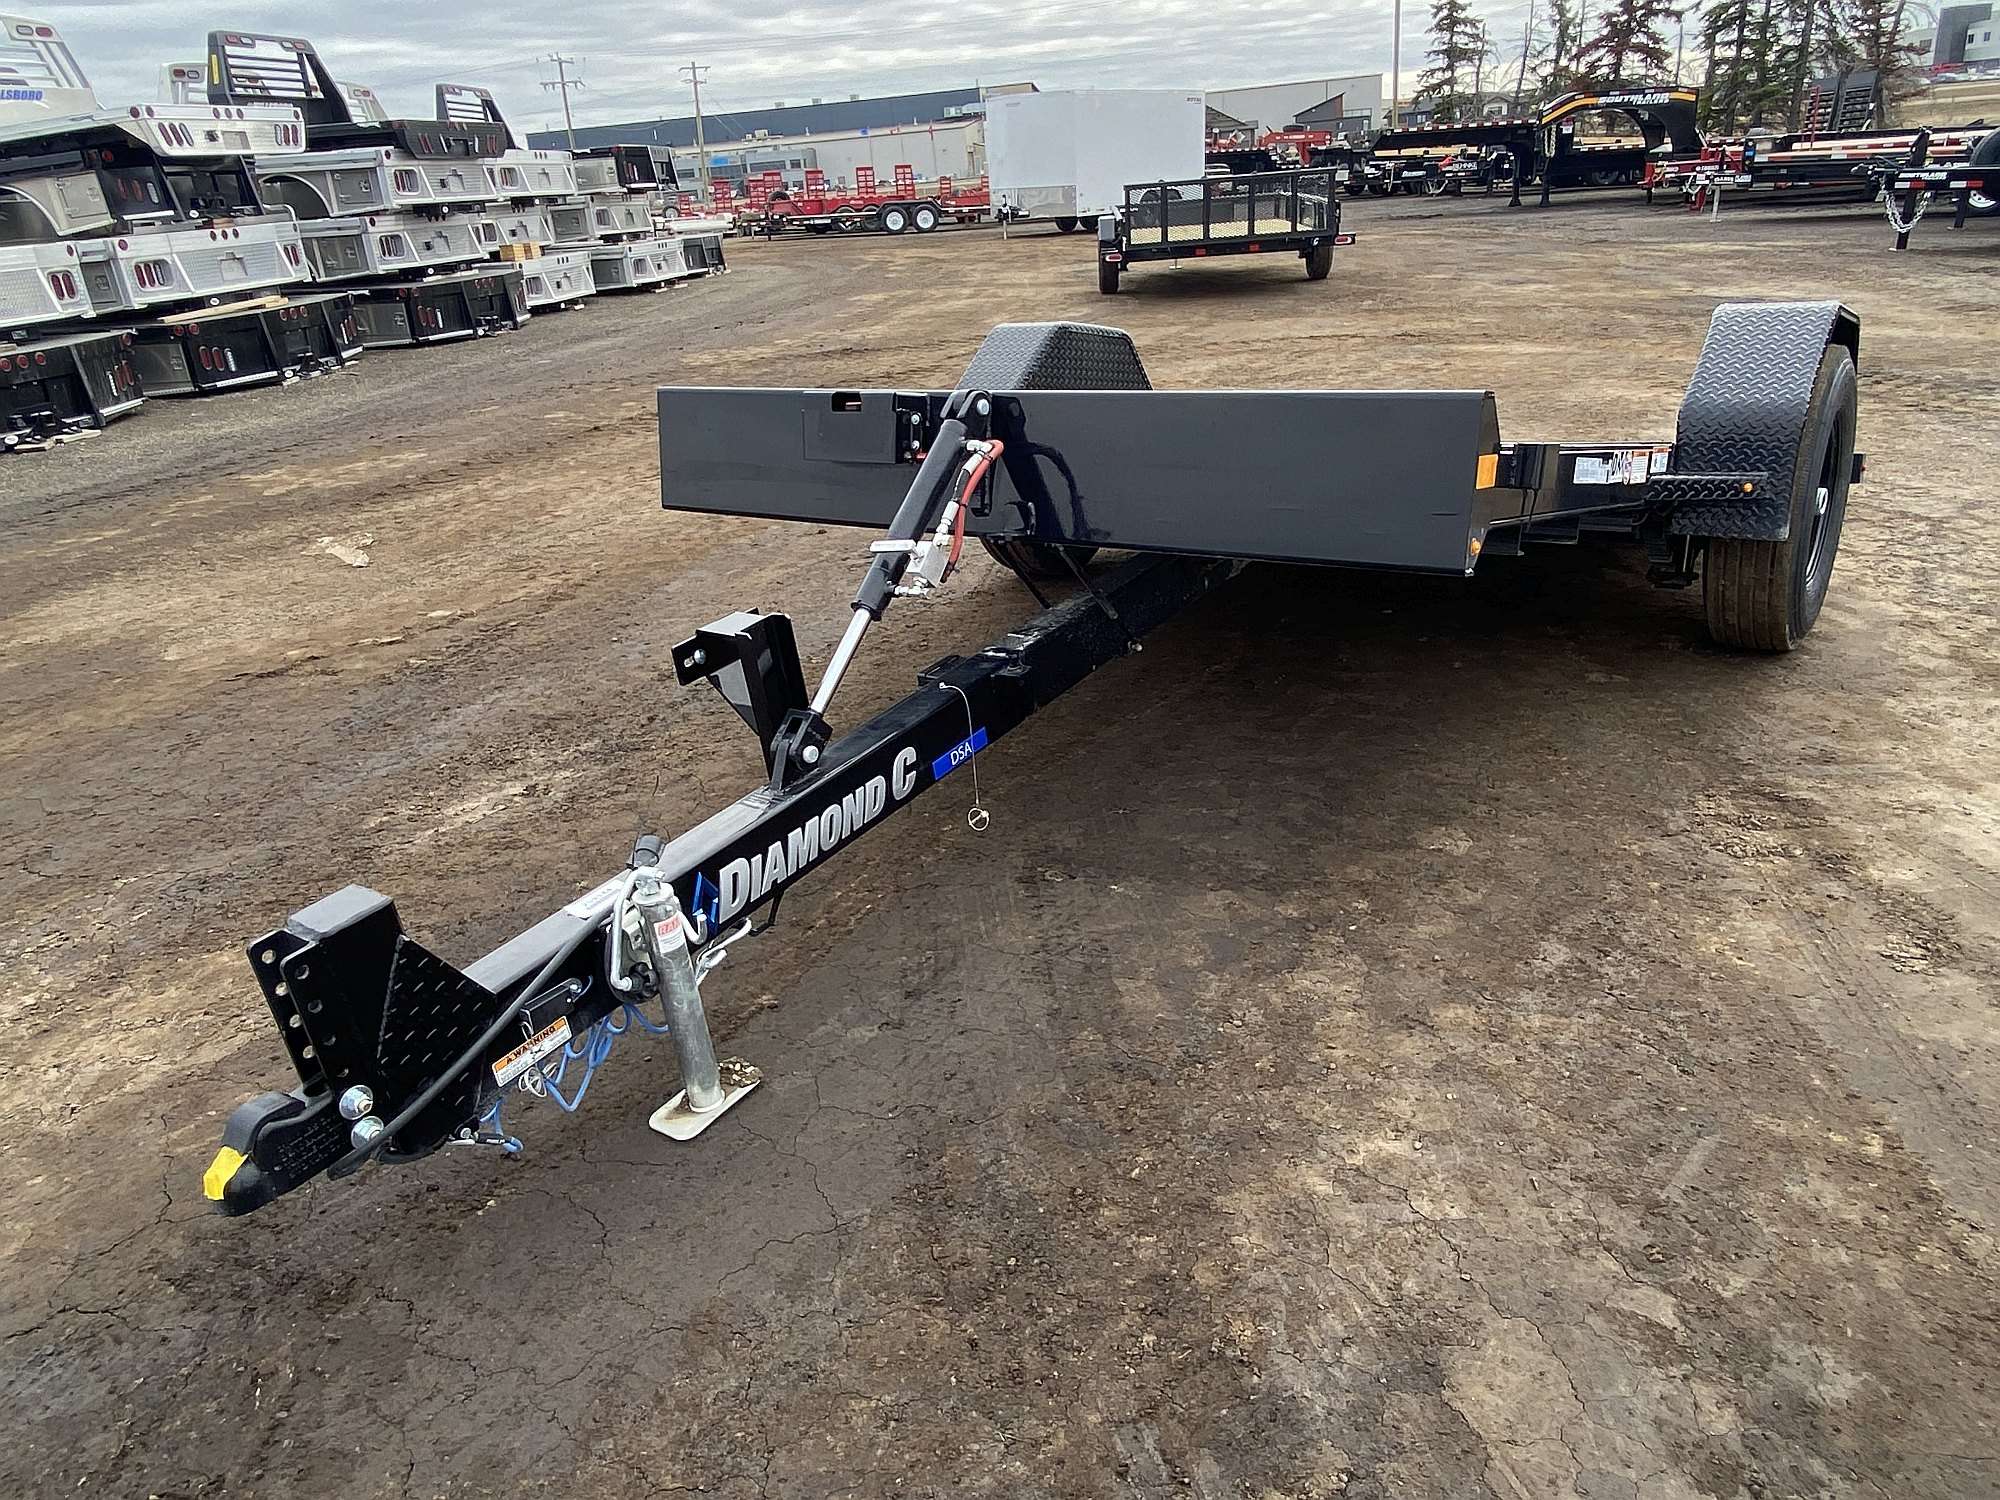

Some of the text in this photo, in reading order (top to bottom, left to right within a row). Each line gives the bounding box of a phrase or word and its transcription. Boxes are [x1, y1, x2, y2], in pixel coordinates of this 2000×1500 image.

[950, 742, 973, 766] DSA
[719, 746, 917, 924] DIAMOND C
